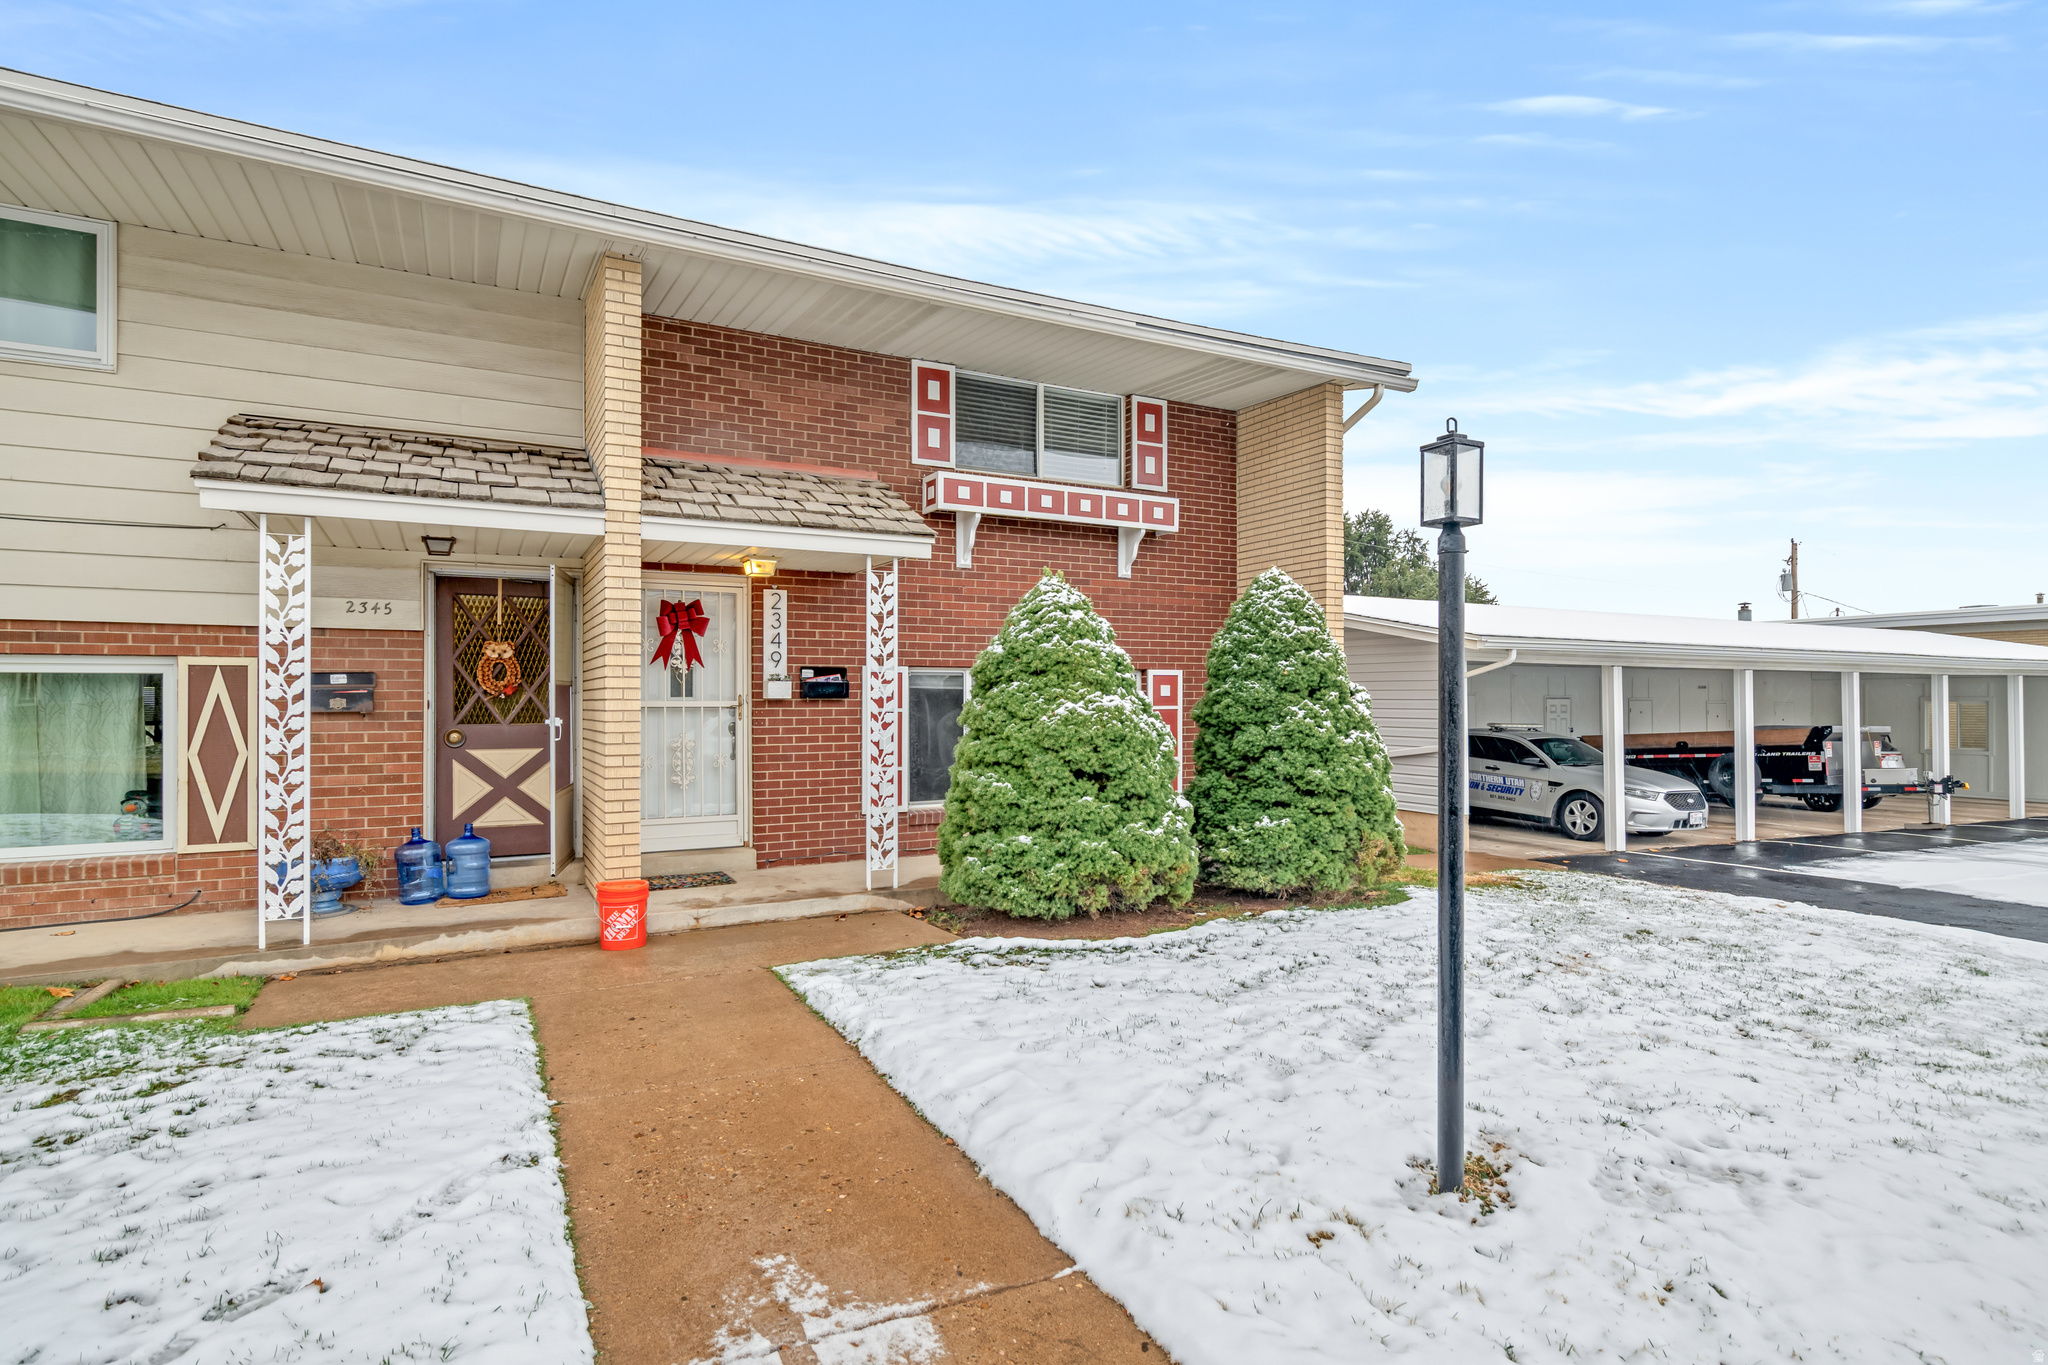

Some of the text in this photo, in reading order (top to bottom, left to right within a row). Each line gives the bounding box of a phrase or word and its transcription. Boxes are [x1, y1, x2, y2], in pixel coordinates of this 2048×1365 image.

[346, 600, 392, 615] 2345
[771, 593, 782, 668] 2349
[1480, 782, 1485, 790] &
[1486, 784, 1524, 796] SECURITY
[1505, 778, 1524, 787] UTAH
[604, 906, 638, 940] HOME
[606, 910, 620, 924] THE
